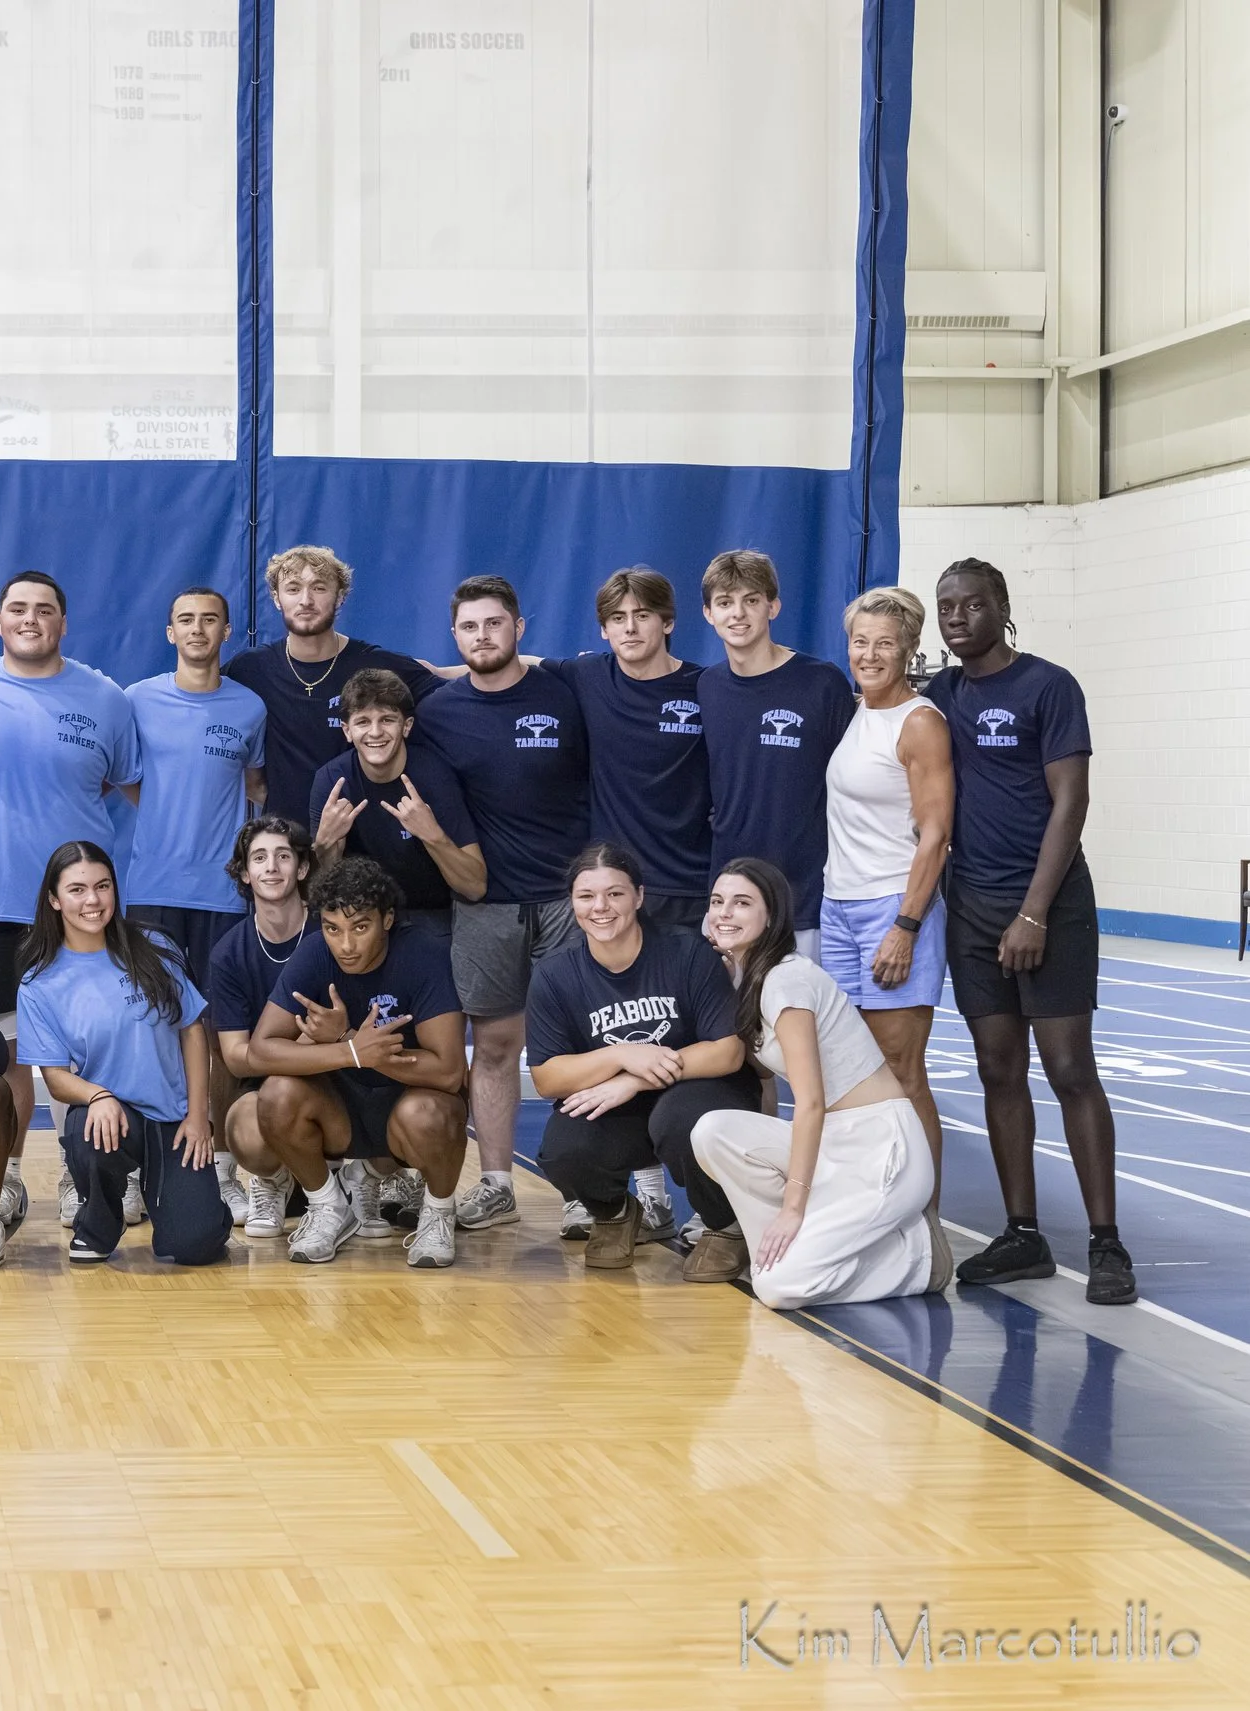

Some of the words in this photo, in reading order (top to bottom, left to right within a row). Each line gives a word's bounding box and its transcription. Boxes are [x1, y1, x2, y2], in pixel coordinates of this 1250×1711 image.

[147, 29, 194, 48] GIRLS
[198, 30, 238, 48] TRAC
[409, 31, 456, 50] GIRLS
[460, 32, 524, 50] SOCCER
[111, 405, 162, 418] CROSS
[166, 405, 233, 418] COUNTRY
[136, 421, 199, 434] DIVISION
[2, 435, 38, 445] 22-0-2
[133, 437, 162, 449] ALL
[165, 437, 210, 449] STATE
[661, 699, 700, 714] PEABOD
[58, 713, 98, 731] PEABODY
[515, 714, 560, 730] PEABODY
[762, 709, 804, 728] PEABODY
[976, 708, 1016, 726] PEABODY
[206, 724, 243, 742] PEABODY
[658, 722, 703, 735] TANNERS
[57, 732, 96, 750] TANNERS
[515, 737, 559, 748] TANNERS
[760, 733, 801, 748] TANNERS
[977, 734, 1018, 747] TANNERS
[589, 996, 679, 1037] PEABODY
